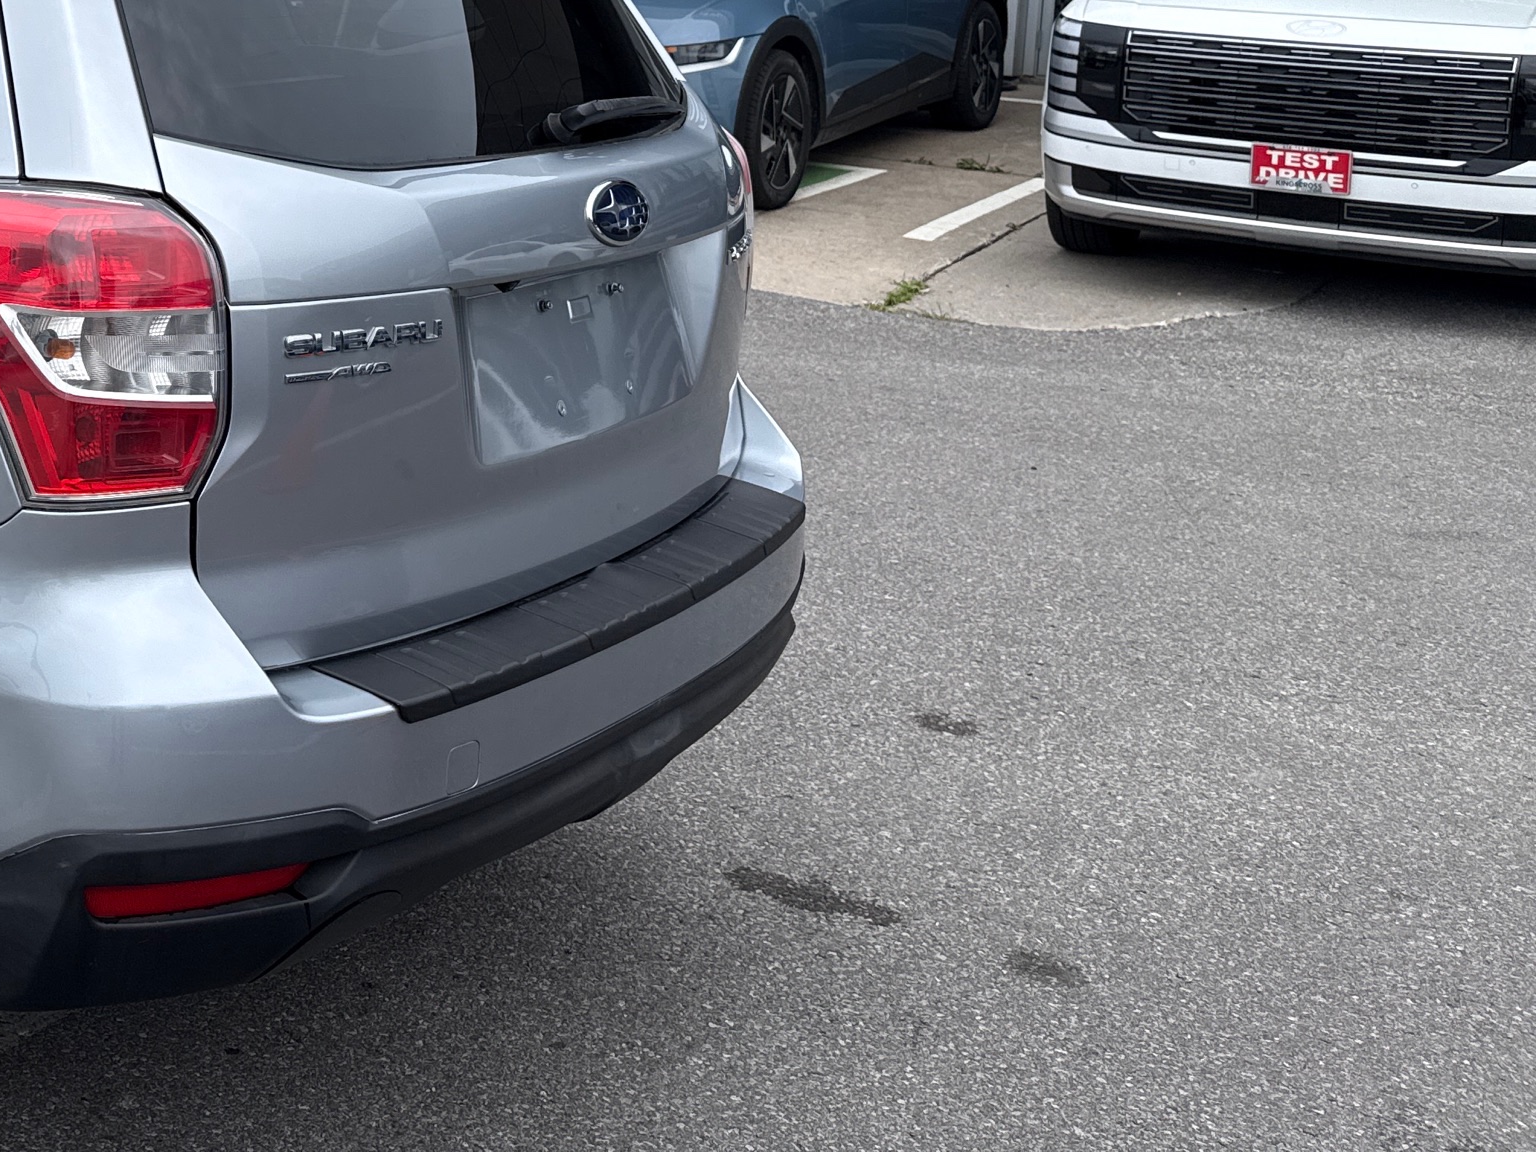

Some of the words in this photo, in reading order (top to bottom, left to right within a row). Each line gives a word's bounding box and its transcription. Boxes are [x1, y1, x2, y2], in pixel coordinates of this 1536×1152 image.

[1265, 149, 1340, 171] TEST
[284, 318, 444, 358] SUBARU
[328, 361, 392, 381] AWD
